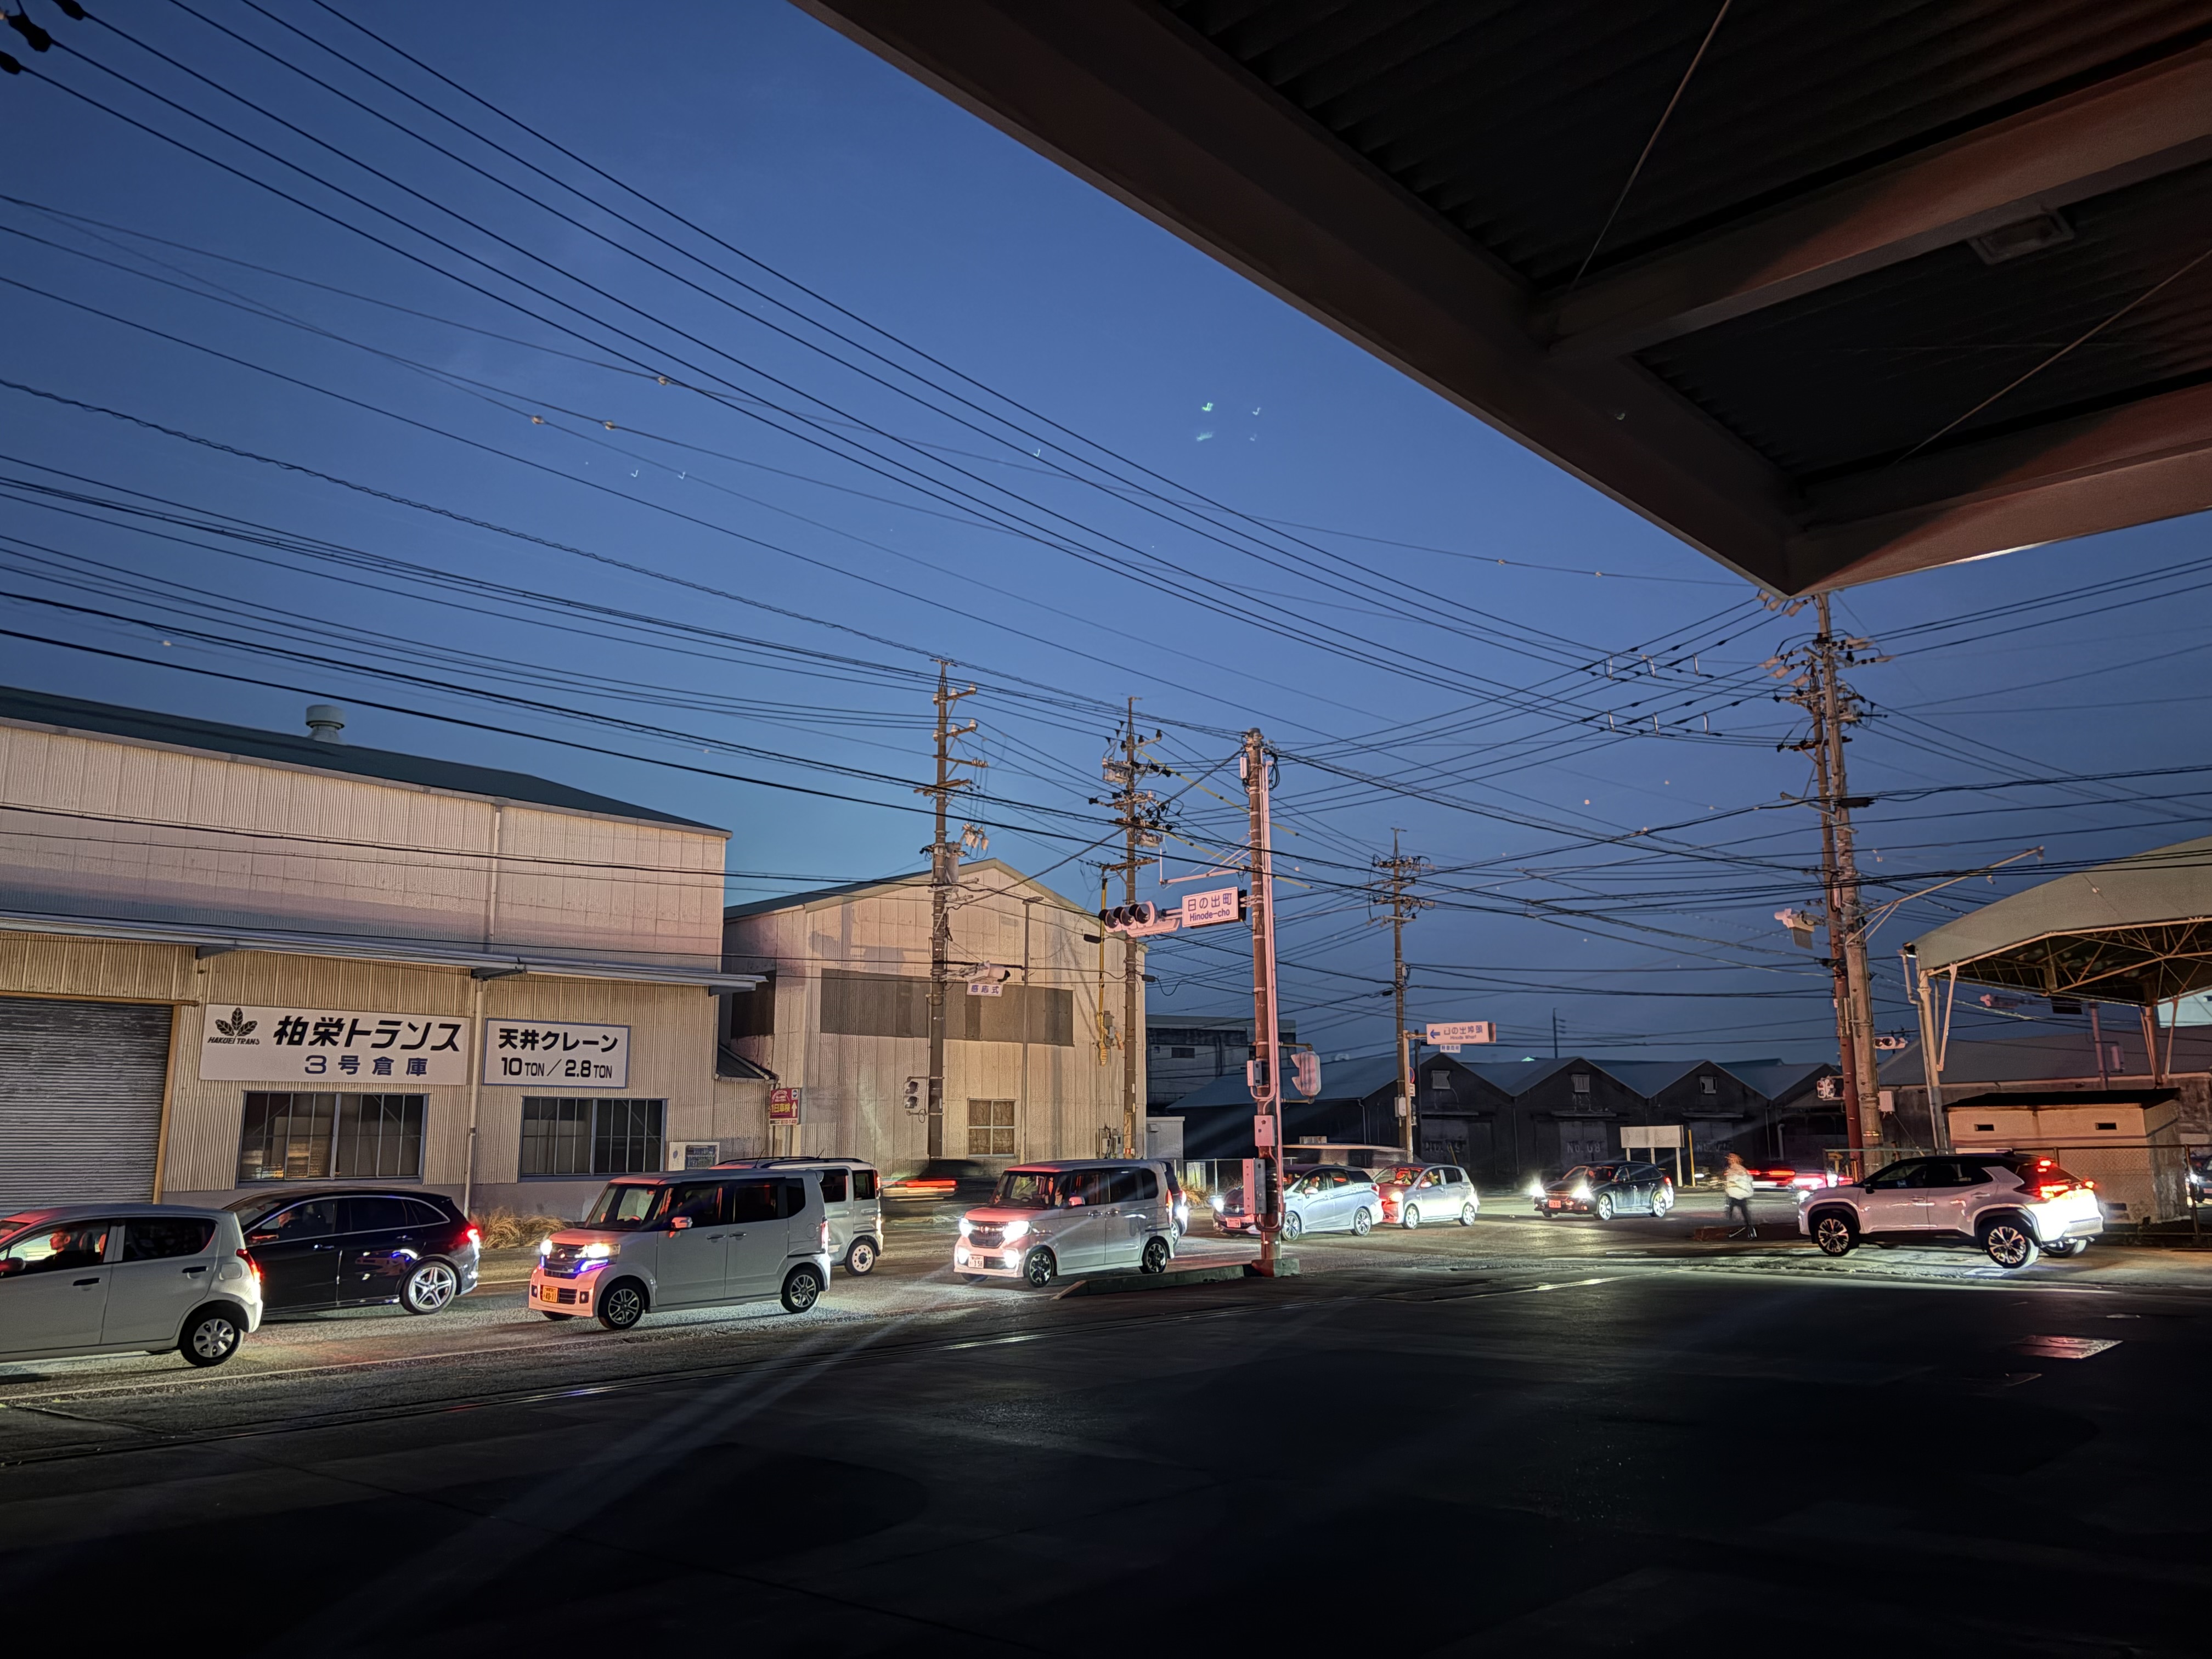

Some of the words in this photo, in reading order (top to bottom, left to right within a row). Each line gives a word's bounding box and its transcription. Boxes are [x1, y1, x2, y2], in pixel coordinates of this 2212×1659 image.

[1188, 893, 1232, 912] 日の出町
[1189, 908, 1230, 922] Hinode-cho
[970, 985, 1000, 994] 感応式
[207, 1035, 236, 1044] HAKUEI
[273, 1015, 462, 1052] 柏栄トランス
[498, 1028, 618, 1052] 天井クレーン
[304, 1054, 428, 1076] 3号倉庫
